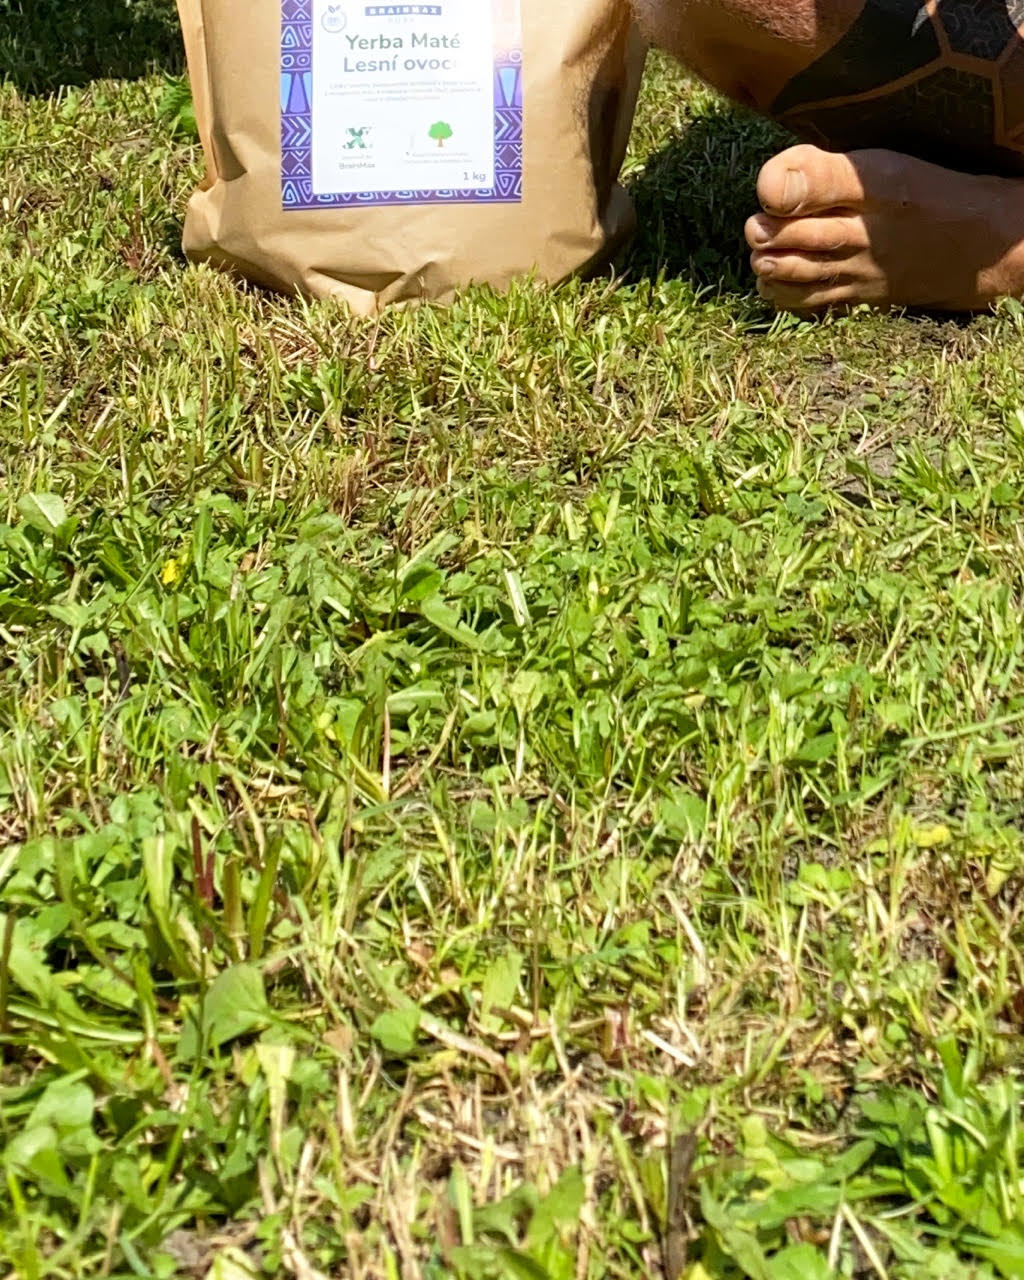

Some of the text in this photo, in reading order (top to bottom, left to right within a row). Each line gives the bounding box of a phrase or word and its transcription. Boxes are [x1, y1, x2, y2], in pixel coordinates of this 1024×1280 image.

[368, 5, 438, 15] BRAINMAX
[344, 32, 461, 51] Yerba Maté
[343, 54, 457, 73] Lesní ovoc
[463, 171, 486, 183] 1 kg
